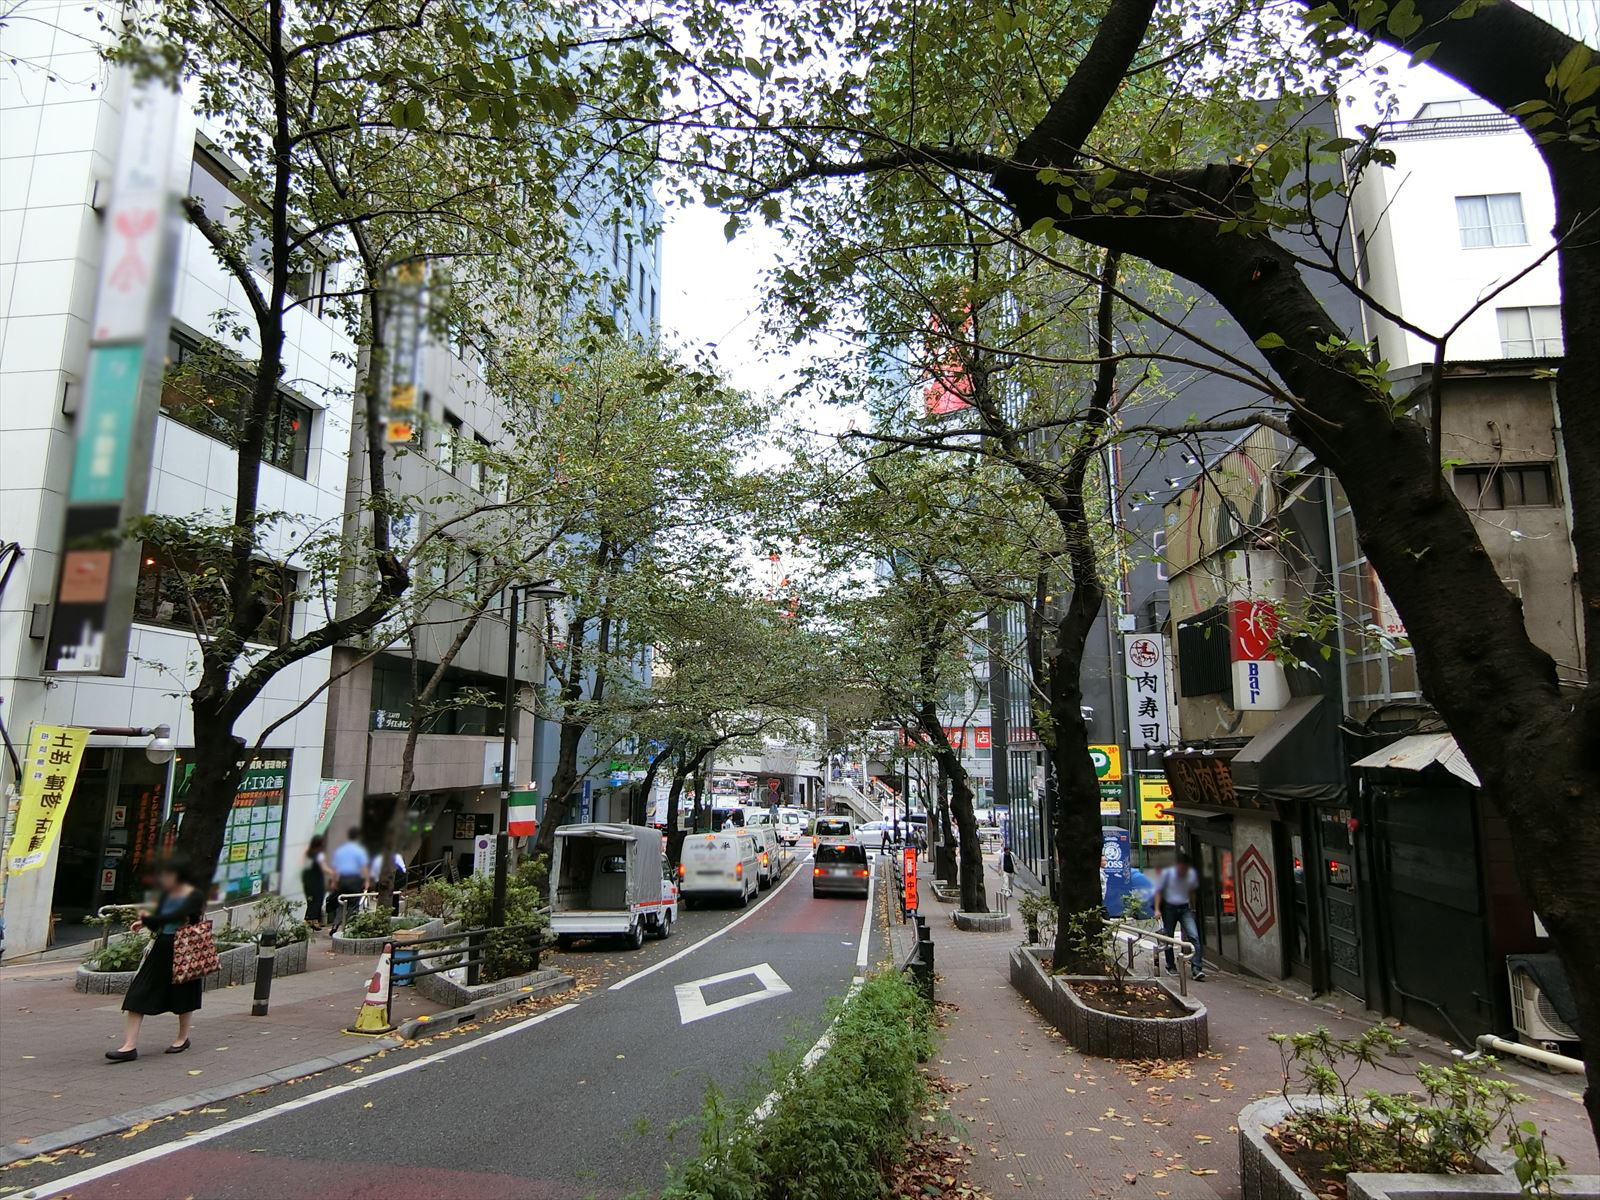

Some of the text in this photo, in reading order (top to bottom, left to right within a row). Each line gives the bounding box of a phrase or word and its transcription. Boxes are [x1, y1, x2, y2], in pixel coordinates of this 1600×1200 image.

[1136, 671, 1161, 743] 肉寿司
[1248, 663, 1260, 704] Bar
